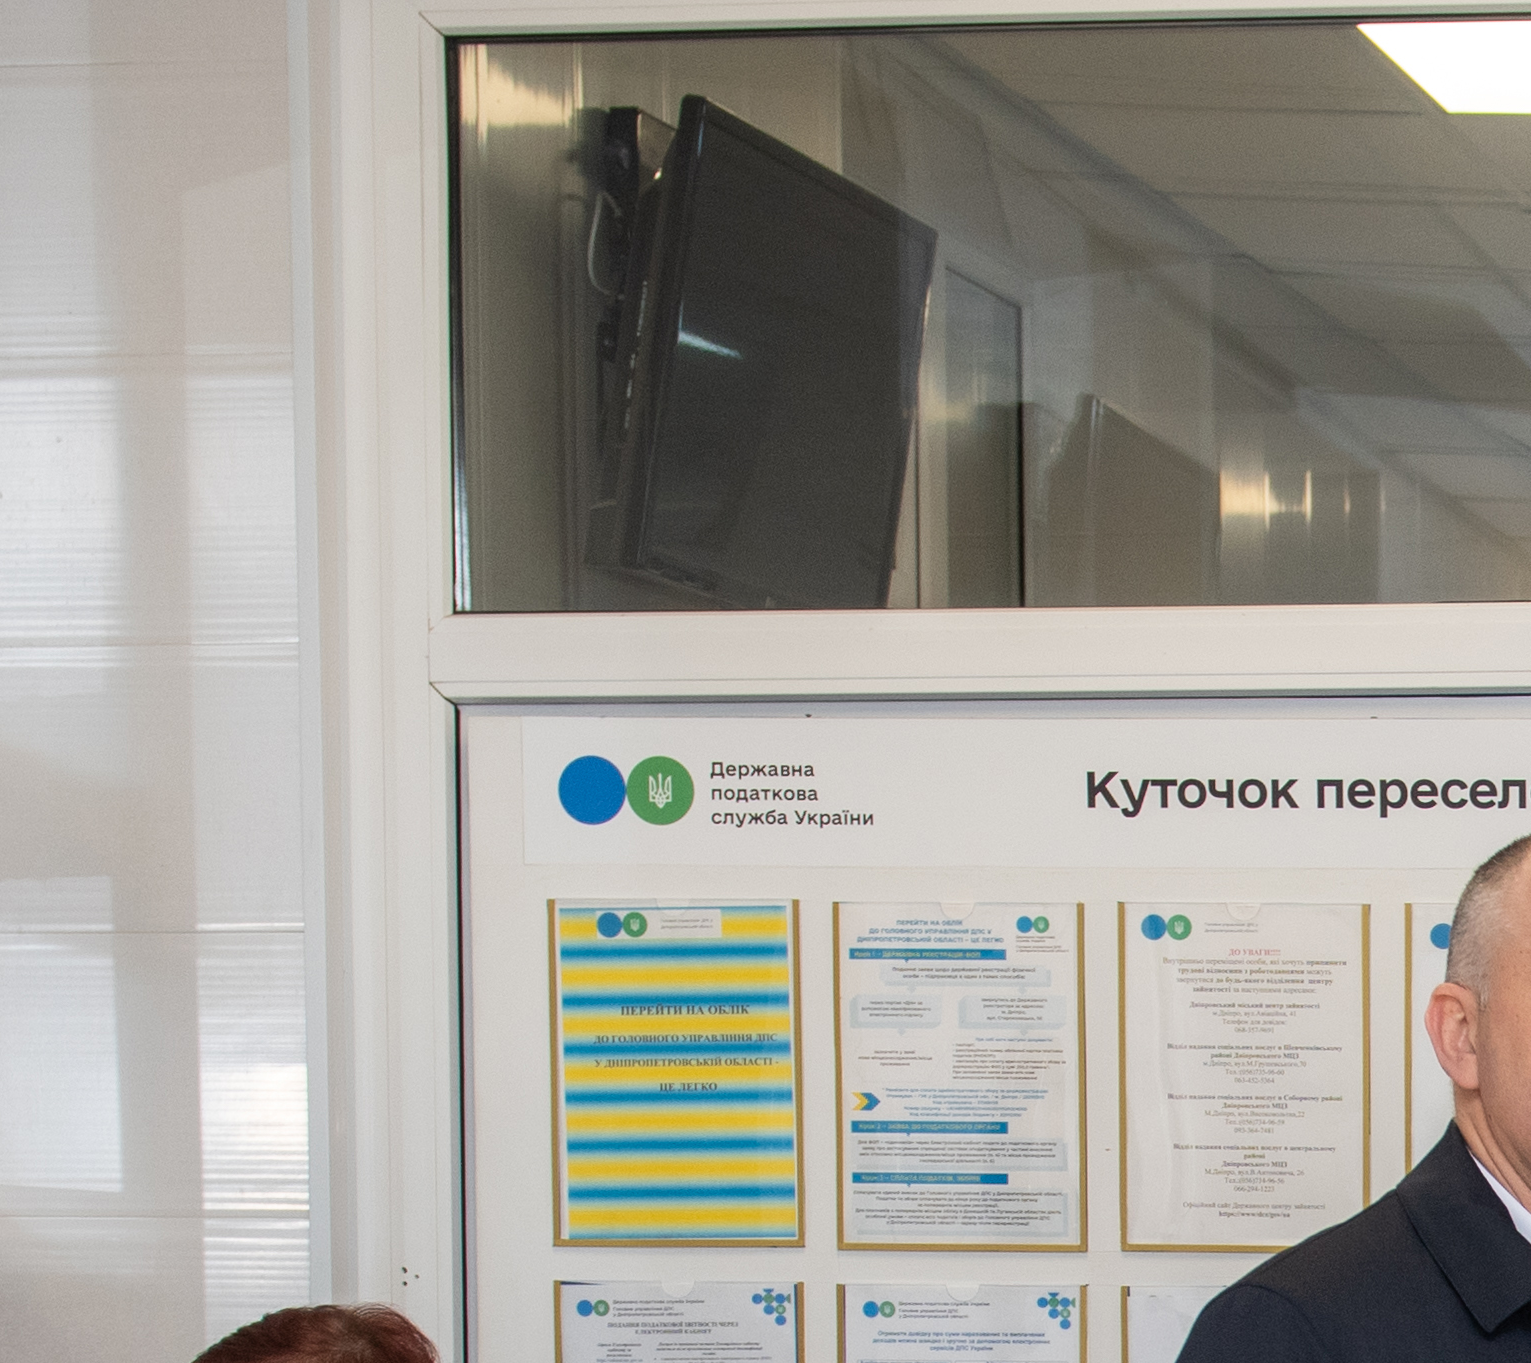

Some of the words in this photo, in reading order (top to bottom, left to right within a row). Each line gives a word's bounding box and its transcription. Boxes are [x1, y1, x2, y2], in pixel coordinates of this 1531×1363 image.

[709, 761, 815, 779] Державна
[710, 787, 819, 803] податкова
[1086, 771, 1300, 817] Куточок
[710, 809, 788, 828] служба
[794, 809, 874, 829] України
[620, 1003, 684, 1016] ПЕРЕЙТИ
[685, 1004, 705, 1016] НА
[707, 1003, 750, 1016] ОБЛІК
[593, 1034, 610, 1045] ДО
[611, 1033, 679, 1044] ГОЛОВНОГО
[680, 1032, 753, 1044] УПРАВЛІННЯ
[754, 1032, 778, 1044] ДПС
[594, 1058, 602, 1068] У
[603, 1057, 723, 1069] ДНІПРОПЕТРОВСЬКІЙ
[723, 1056, 773, 1067] ОБЛАСТІ
[659, 1082, 675, 1094] ЦЕ
[677, 1081, 718, 1093] ЛЕГКО
